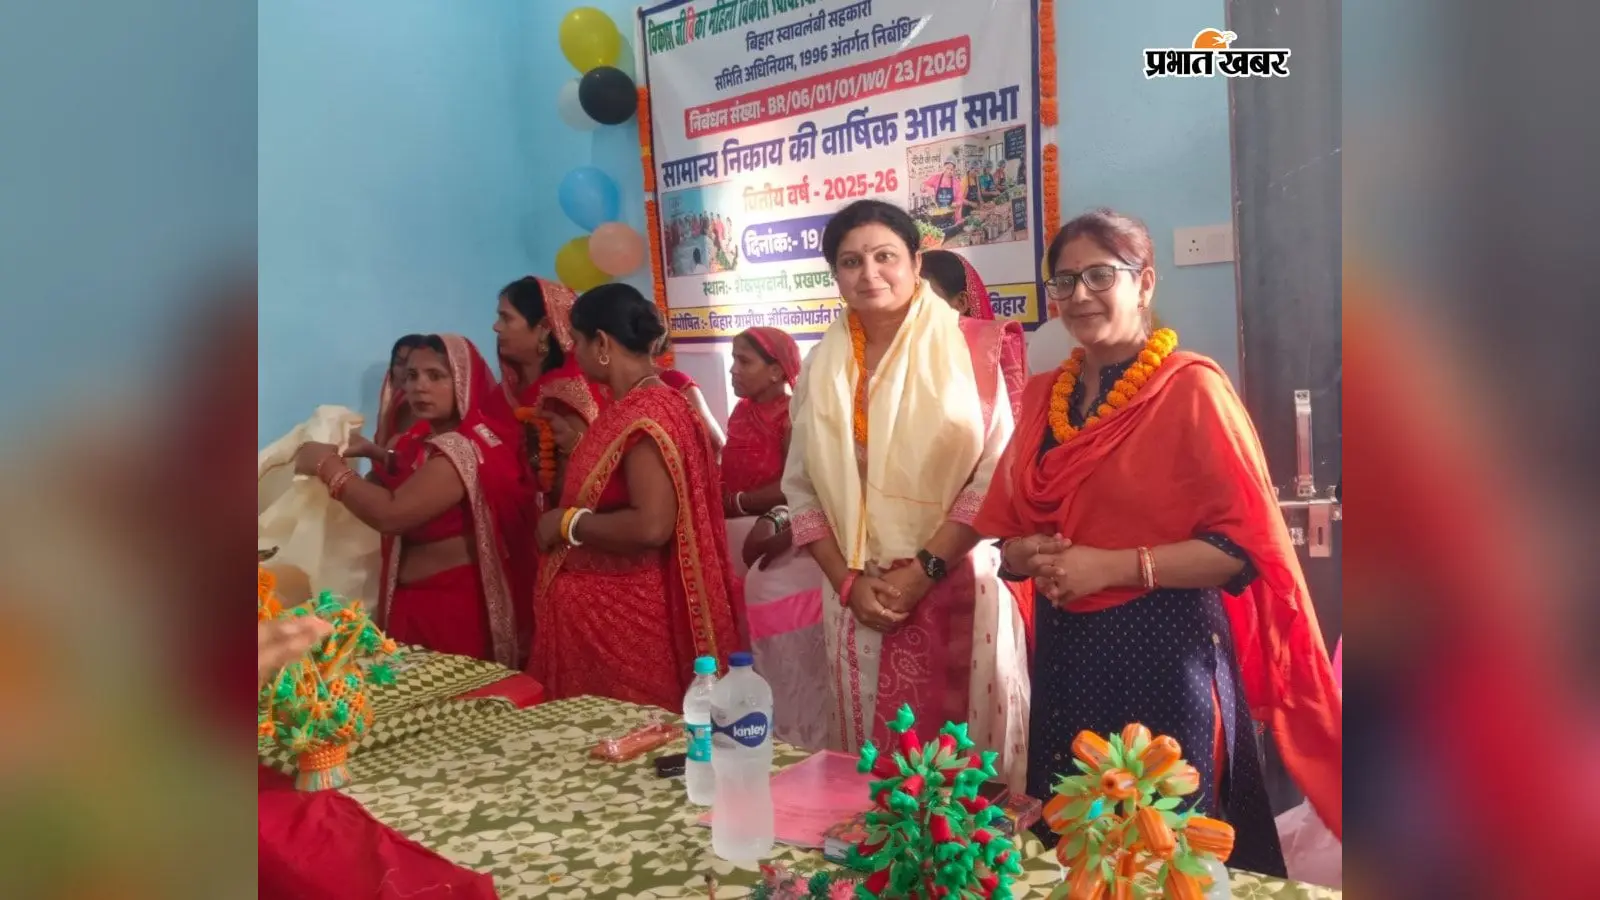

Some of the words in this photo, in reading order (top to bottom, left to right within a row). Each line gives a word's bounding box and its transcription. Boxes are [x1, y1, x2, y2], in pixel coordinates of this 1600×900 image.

[746, 30, 774, 52] बिहार
[776, 9, 826, 41] स्वावलंबी
[714, 64, 743, 91] समिति
[744, 54, 797, 82] अधिनियम,
[799, 45, 827, 67] 1996
[872, 16, 924, 48] निबंधि
[689, 107, 728, 132] निबंधन
[894, 47, 967, 83] 23/2026
[661, 150, 719, 188] सामान्य
[721, 138, 786, 176] निकाय
[788, 121, 818, 162] की
[821, 106, 899, 156] वार्षिक
[904, 99, 959, 142] आम
[961, 85, 1020, 129] सभा
[787, 175, 810, 206] वर्ष
[823, 168, 899, 201] 2025-26
[709, 311, 733, 331] बिहार
[733, 724, 766, 737] kinley
